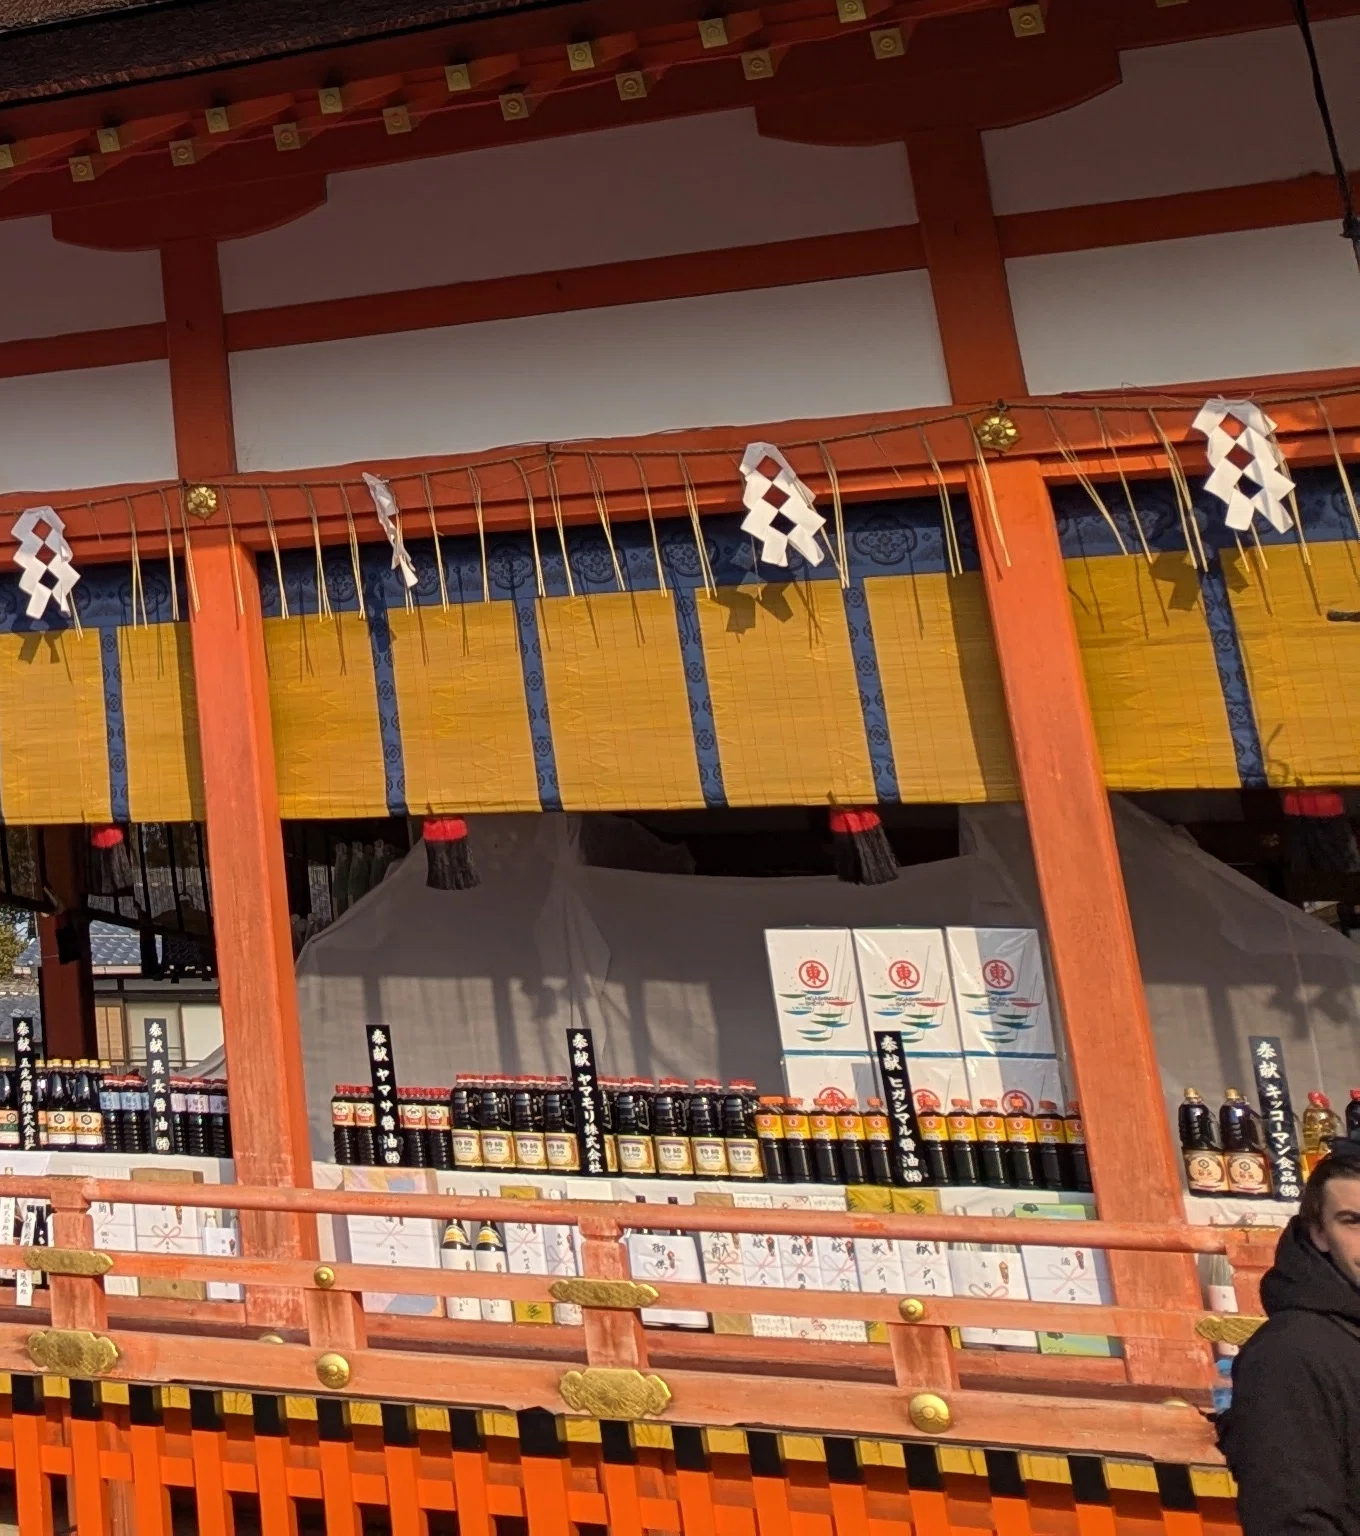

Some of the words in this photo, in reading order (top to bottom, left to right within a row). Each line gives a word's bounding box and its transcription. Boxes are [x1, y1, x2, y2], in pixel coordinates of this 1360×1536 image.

[804, 961, 827, 987] 東
[894, 961, 919, 987] 東
[988, 961, 1012, 986] 東
[371, 1028, 390, 1062] 奉献
[572, 1032, 591, 1067] 奉献
[880, 1035, 902, 1071] 奉献
[1256, 1041, 1281, 1079] 奉献
[577, 1073, 603, 1173] ヤマモリ株式会社
